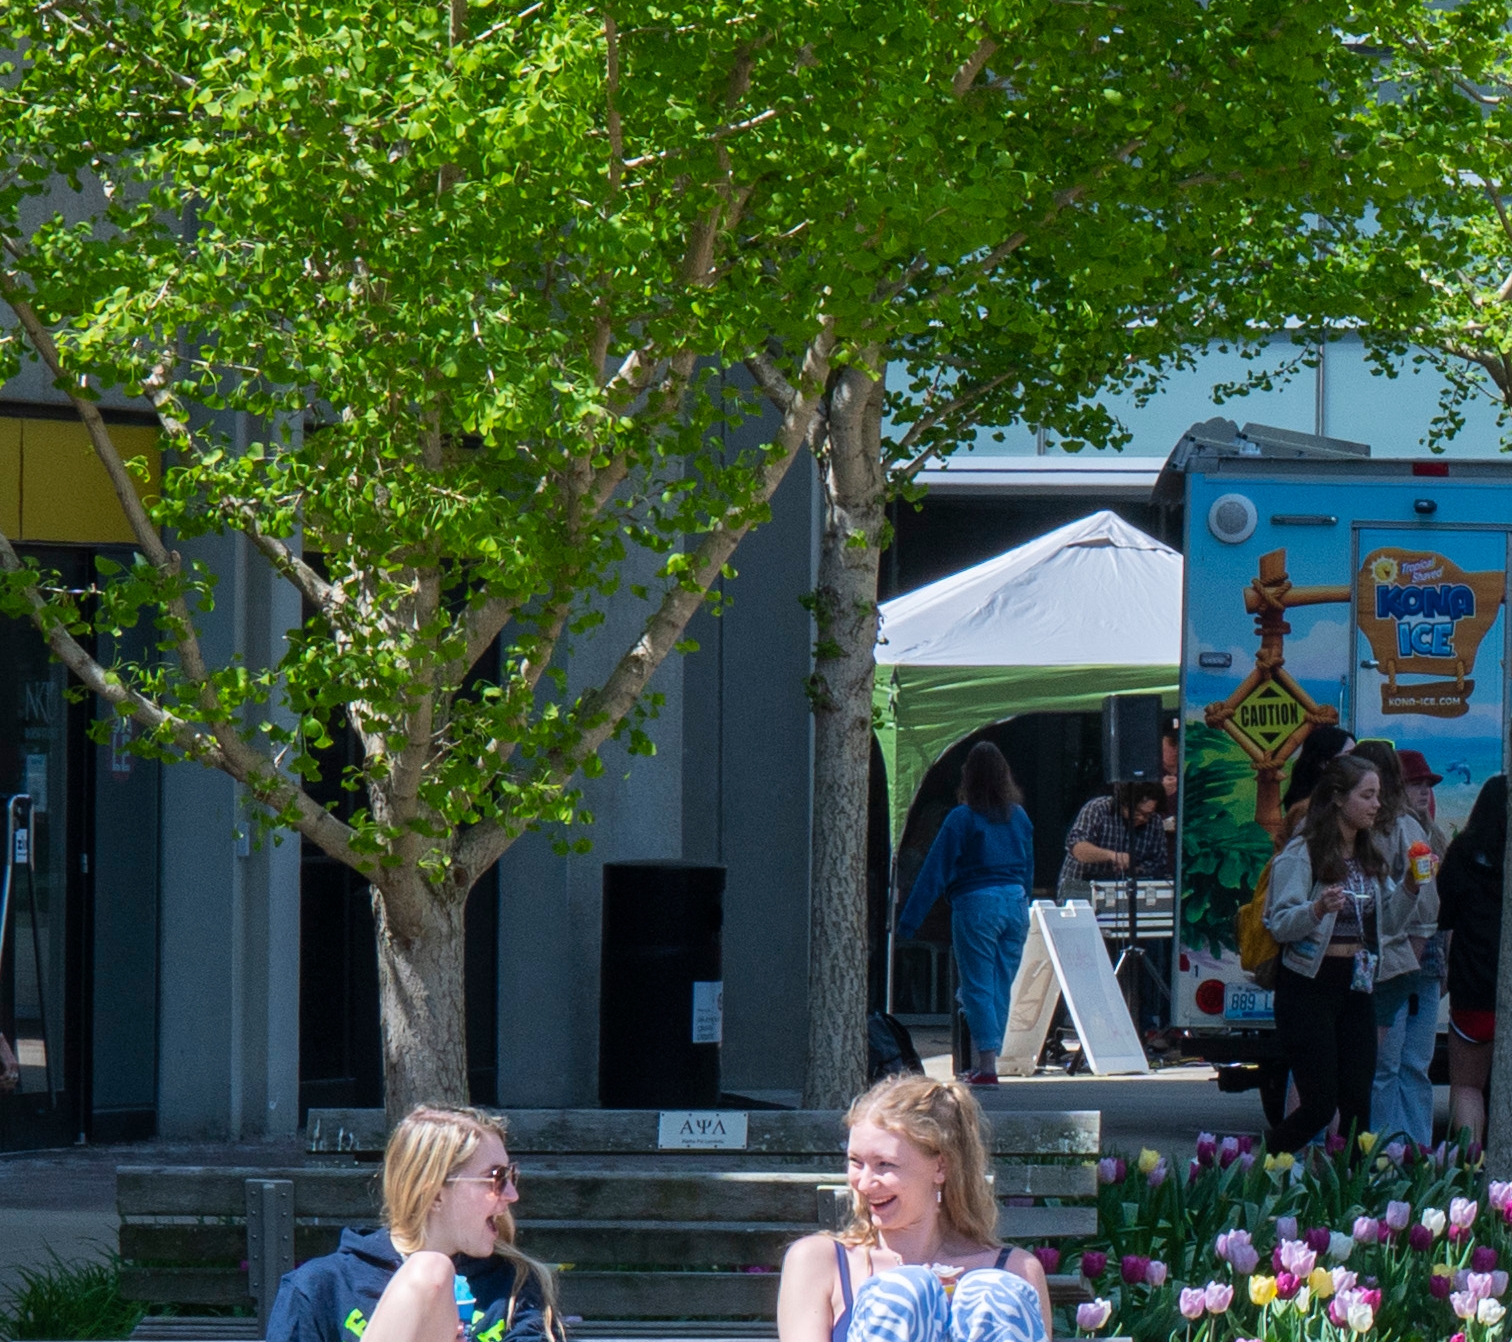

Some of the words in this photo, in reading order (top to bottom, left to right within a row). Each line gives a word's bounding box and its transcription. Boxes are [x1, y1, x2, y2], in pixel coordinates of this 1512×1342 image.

[1375, 583, 1475, 621] KONA
[1397, 621, 1456, 658] ICE
[1241, 703, 1299, 728] CAUTION
